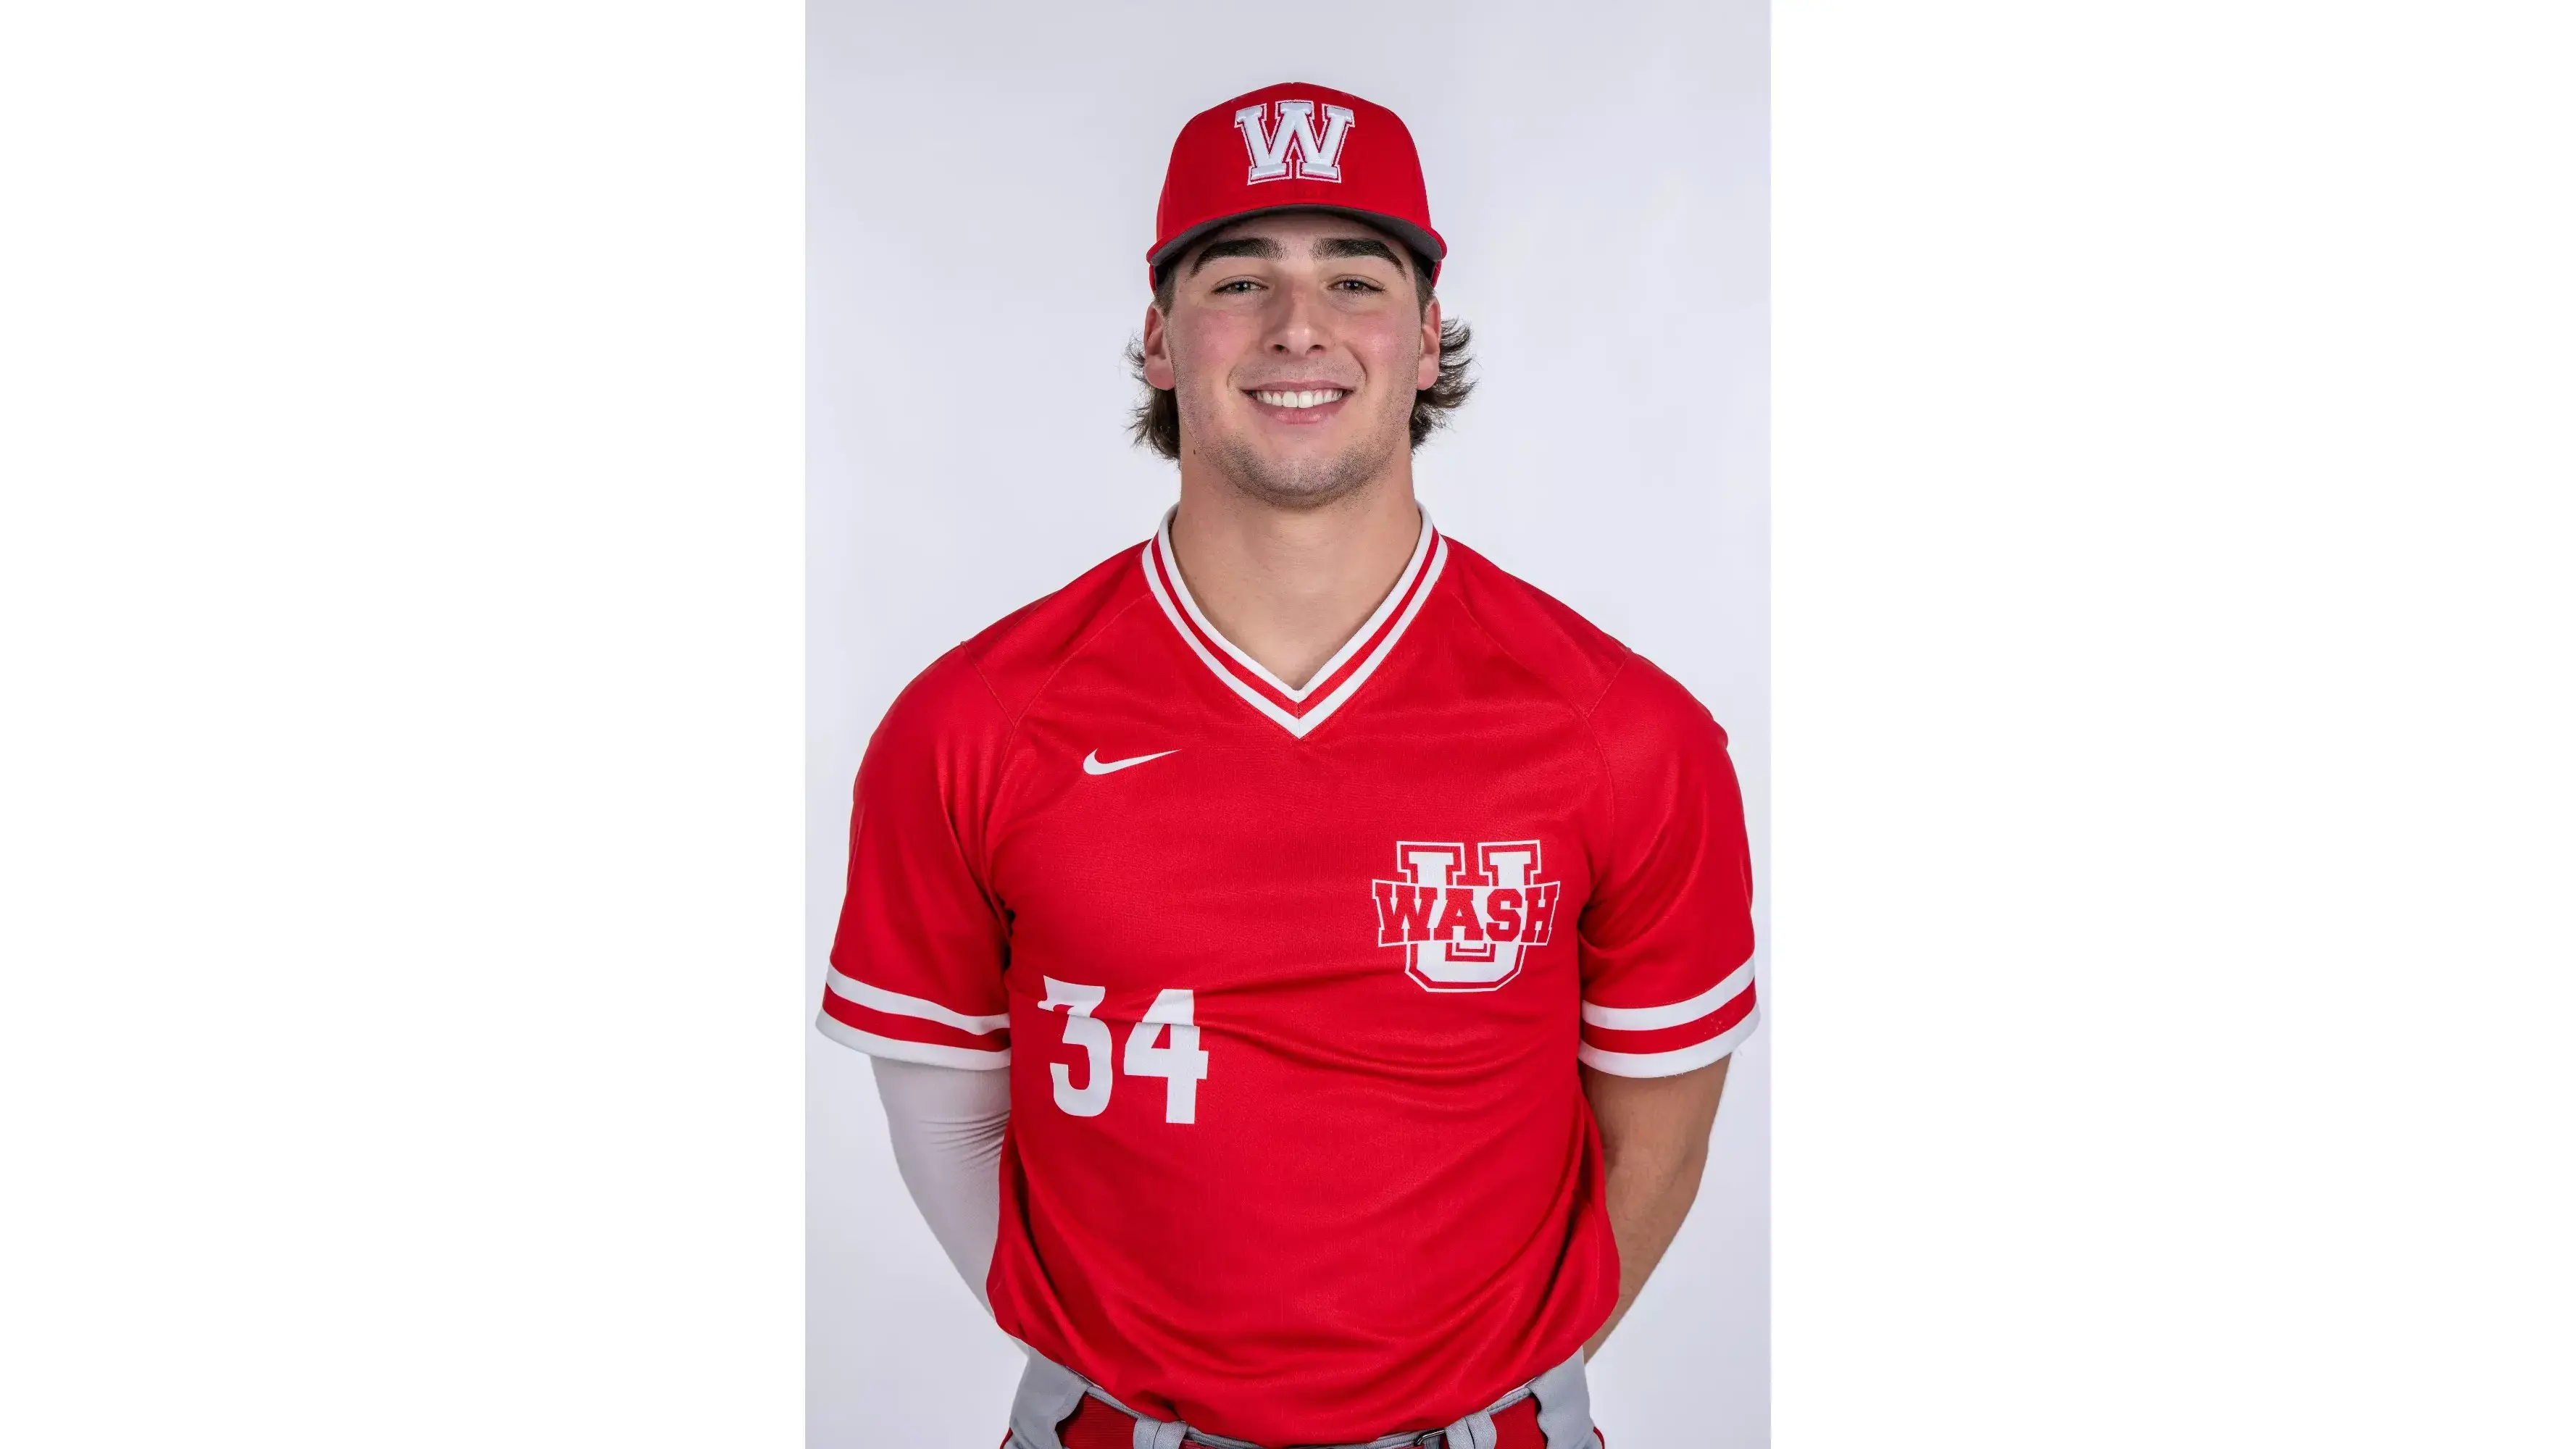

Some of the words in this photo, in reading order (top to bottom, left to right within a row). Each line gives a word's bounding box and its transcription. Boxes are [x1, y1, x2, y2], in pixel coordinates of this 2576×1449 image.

[1234, 100, 1355, 185] W
[1373, 880, 1560, 947] WASH
[1396, 840, 1541, 992] U
[1038, 975, 1209, 1124] 34
